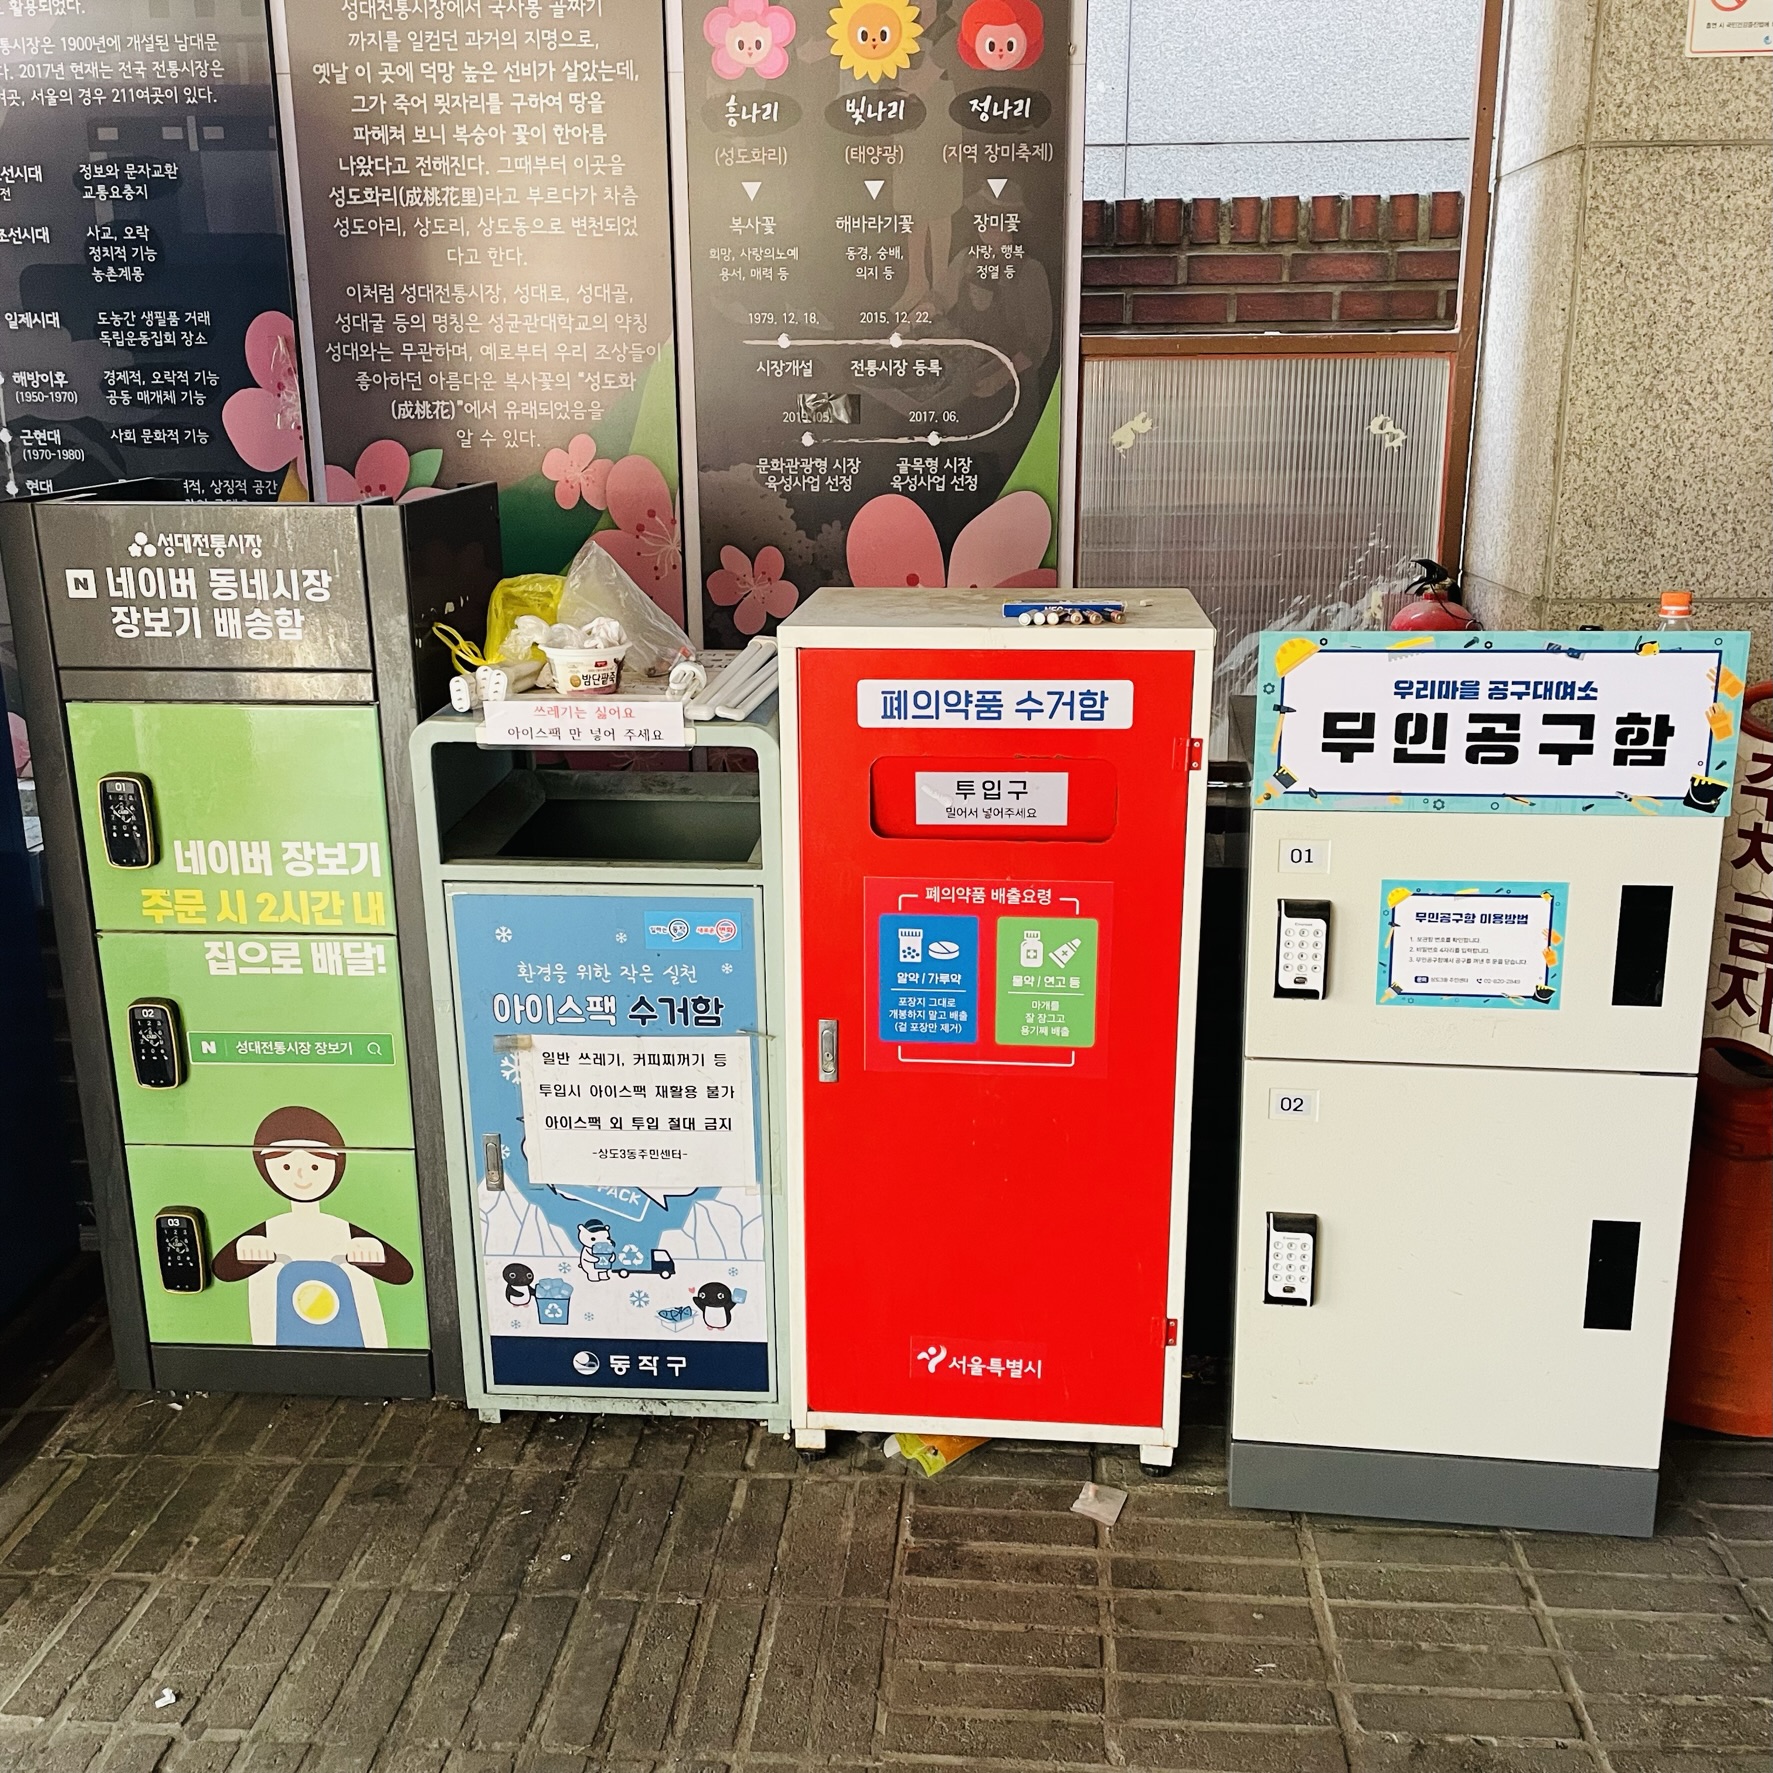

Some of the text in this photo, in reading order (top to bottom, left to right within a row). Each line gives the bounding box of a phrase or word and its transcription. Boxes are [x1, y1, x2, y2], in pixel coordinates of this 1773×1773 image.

[60, 33, 220, 53] 1900년에 개설된 남대문
[19, 59, 225, 80] 2017년 현재는 전국 전통시장은
[312, 60, 639, 84] 옛날 이 곳에 덕망 높은 선비가 살았는데,
[31, 86, 217, 107] 서울의 경우 211여곳이 있다.
[845, 95, 905, 126] 빛나리
[968, 95, 1032, 122] 정나리
[353, 123, 607, 146] 파헤쳐 보니 복숭아 꽃이 한아름
[714, 147, 788, 166] (성도화리)
[844, 145, 904, 165] (태양광)
[942, 143, 1054, 163] (지역 장미축제)
[78, 162, 178, 180] 정보와 문자교환
[339, 155, 626, 176] 나왔다고 전해진다. 그때부터 이곳을
[82, 184, 148, 201] 교통요충지
[729, 216, 777, 235] 복사꽃
[835, 214, 914, 235] 해바라기꽃
[973, 213, 1021, 233] 장미꽃
[4, 312, 60, 329] 일제시대
[97, 310, 211, 327] 도농간 생필품 거래
[748, 312, 820, 325] 1979. 12. 18.
[859, 311, 933, 324] 2015. 12. 22.
[756, 360, 813, 378] 시장개설
[850, 359, 942, 377] 전통시장 등록
[12, 371, 68, 388] 해방이후
[103, 369, 220, 387] 경제적, 오락적 기능
[15, 390, 78, 404] (1950-1970)
[908, 410, 959, 423] 2017. 06.
[19, 429, 61, 446] 근현대
[756, 457, 861, 475] 문화관광형 시장
[896, 456, 972, 475] 골목형 시장
[765, 474, 852, 492] 육성사업 선정
[890, 474, 978, 492] 육성사업 선정
[157, 533, 262, 558] 성대전통시장
[73, 567, 332, 603] N 네이버 동네시장
[111, 606, 305, 641] 장보기 배송함
[1393, 679, 1599, 701] 우리마을 공구대여소
[533, 705, 636, 721] 쓰레기는 싫어요
[881, 689, 1110, 722] 폐의약품 수거함
[507, 726, 665, 742] 아이스팩 만 넣어 주세요
[1321, 711, 1676, 767] 무인공구함
[115, 782, 126, 792] 01
[955, 780, 1030, 801] 투입구
[946, 807, 1038, 820] 밀어서 넣어주세요
[174, 840, 381, 877] 네이버 장보기
[1290, 848, 1313, 864] 01
[925, 886, 1052, 906] 폐의약품 배출요령
[141, 889, 386, 927] 주문 시 2시간 내
[1415, 912, 1529, 925] 무인공구함 이용방법
[204, 941, 387, 977] 집으로 배달!
[517, 962, 698, 985] 환경을 위한 작은 실천
[897, 972, 962, 985] 알약 가루약
[1012, 975, 1081, 988] 물약 연고 등
[492, 993, 725, 1027] 아이스팩 수거함
[898, 997, 957, 1008] 포장지 그대로
[1031, 1000, 1060, 1011] 마개를
[142, 1008, 155, 1018] 02
[888, 1009, 968, 1021] 개봉하지 말고 배출
[1037, 1013, 1066, 1024] 잠그고
[910, 1022, 938, 1033] 포장만
[940, 1022, 962, 1034] 제거)
[1020, 1025, 1070, 1037] 용기째 배출
[201, 1040, 353, 1056] N 성대전통시장 장보기
[542, 1051, 728, 1067] 일반 쓰레기, 커피찌꺼기 등
[539, 1084, 735, 1099] 투입시 아이스팩 재활용 불가
[1280, 1097, 1304, 1112] 02
[545, 1116, 733, 1131] 아이스팩 외 투입 절대 금지
[592, 1148, 689, 1161] -상도3동주민센터-
[168, 1219, 180, 1227] 03
[609, 1354, 687, 1377] 동작구
[948, 1355, 1042, 1379] 서울특별시
